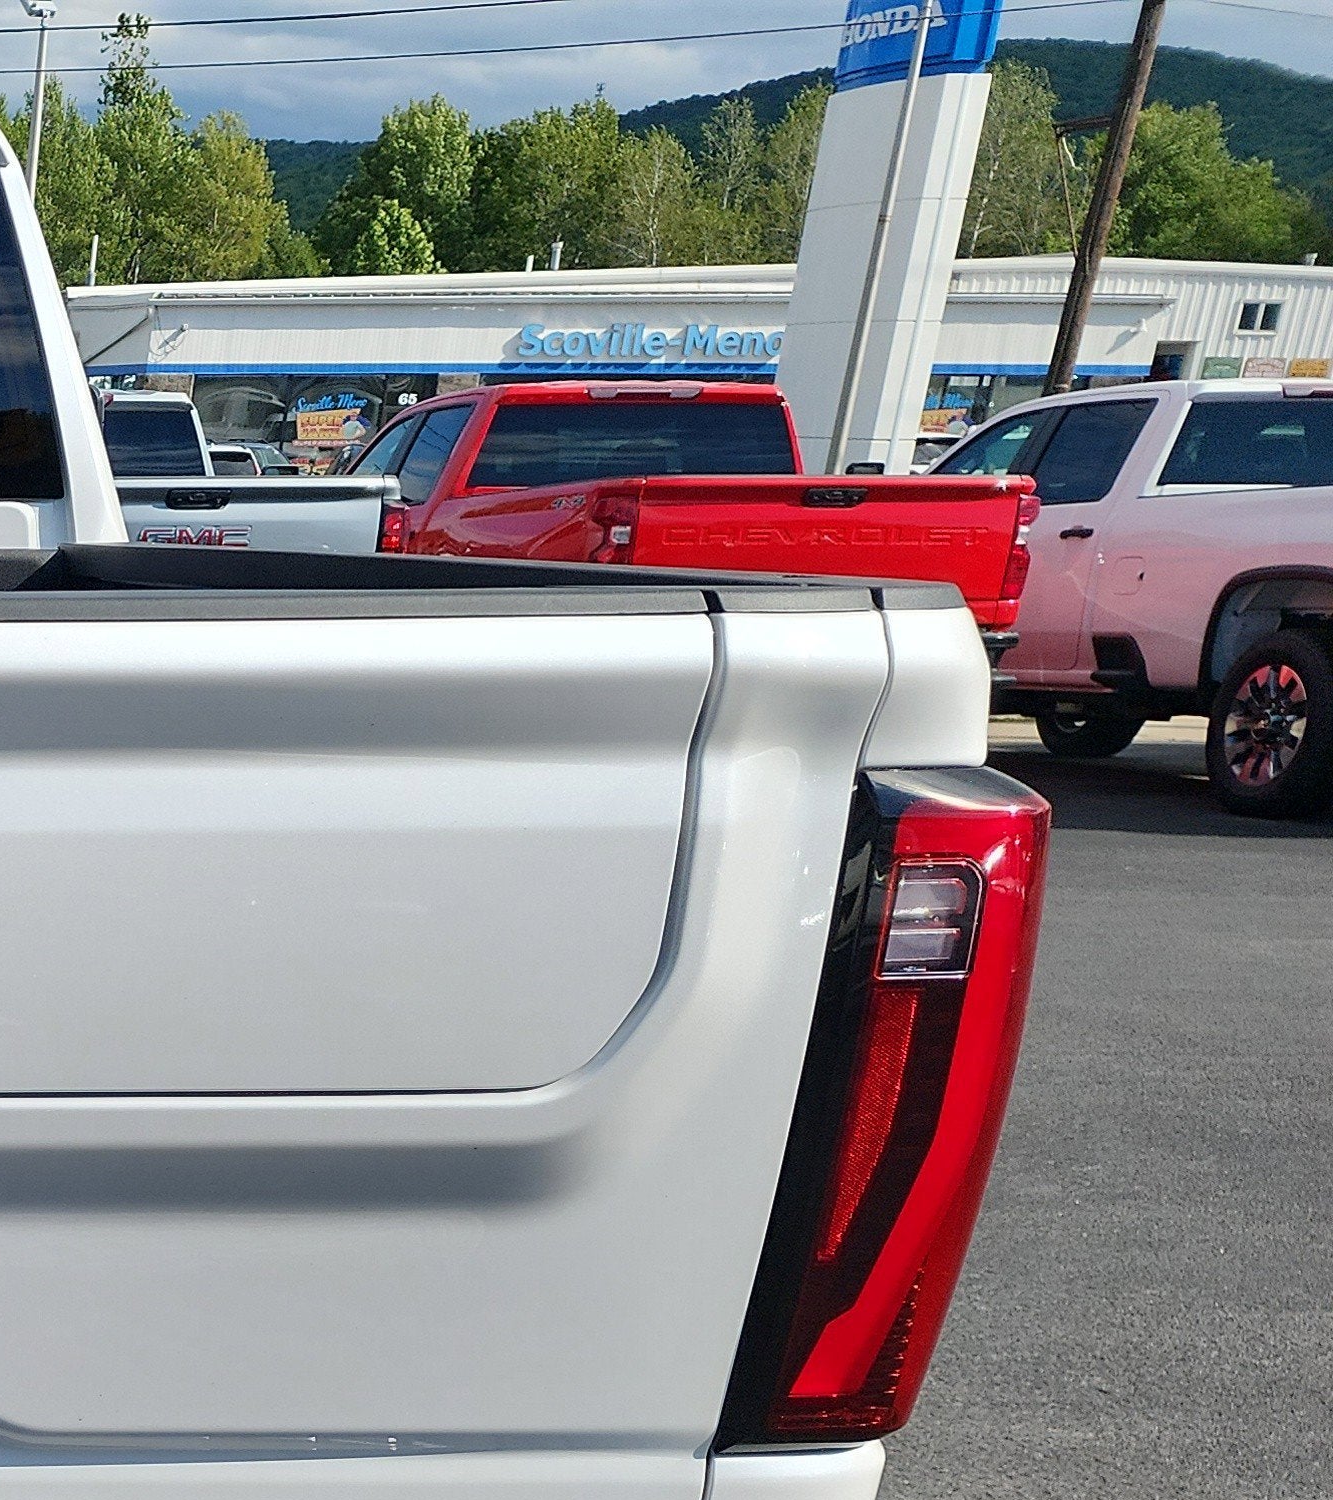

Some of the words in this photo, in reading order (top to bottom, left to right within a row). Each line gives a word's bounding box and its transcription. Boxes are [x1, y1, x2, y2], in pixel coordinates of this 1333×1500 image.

[398, 393, 418, 405] 65
[138, 525, 252, 547] GMC
[661, 527, 990, 548] CHEVROLET
